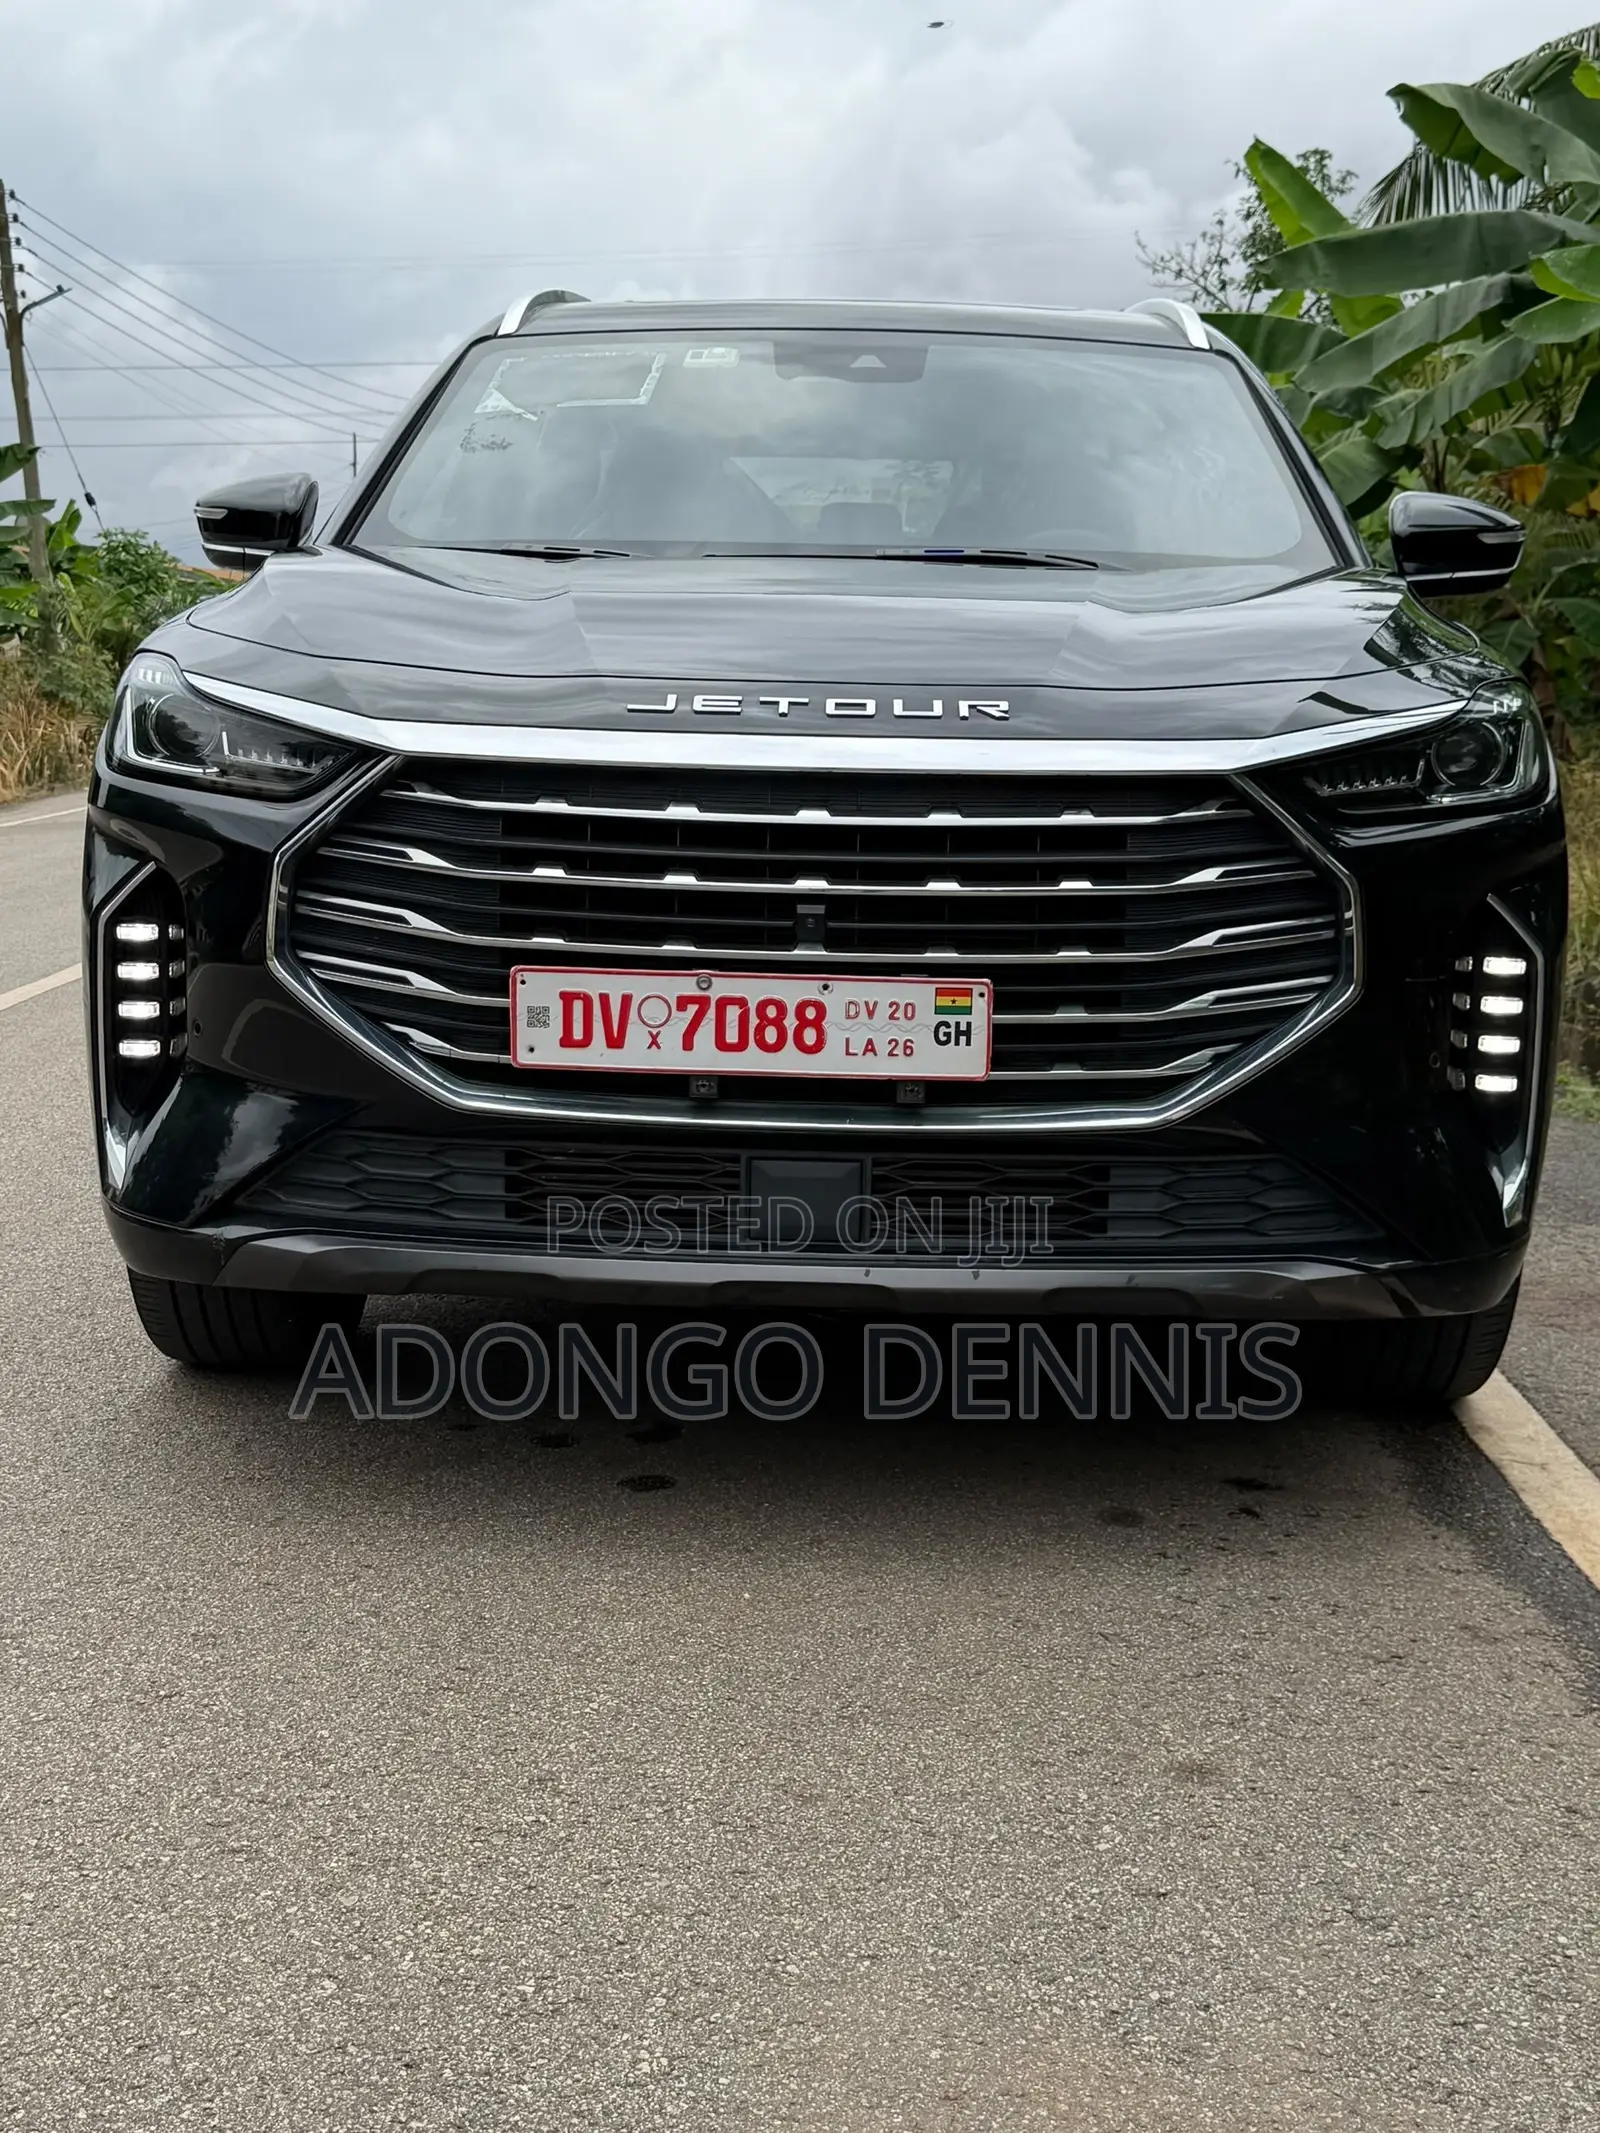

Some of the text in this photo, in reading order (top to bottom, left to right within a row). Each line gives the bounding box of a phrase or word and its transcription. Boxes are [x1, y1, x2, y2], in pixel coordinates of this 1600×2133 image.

[627, 694, 1010, 720] JETOUR
[558, 990, 631, 1049] DV
[676, 995, 827, 1054] 7088
[845, 1000, 916, 1021] DV 20
[845, 1037, 914, 1057] LA 26
[933, 1021, 972, 1047] GH
